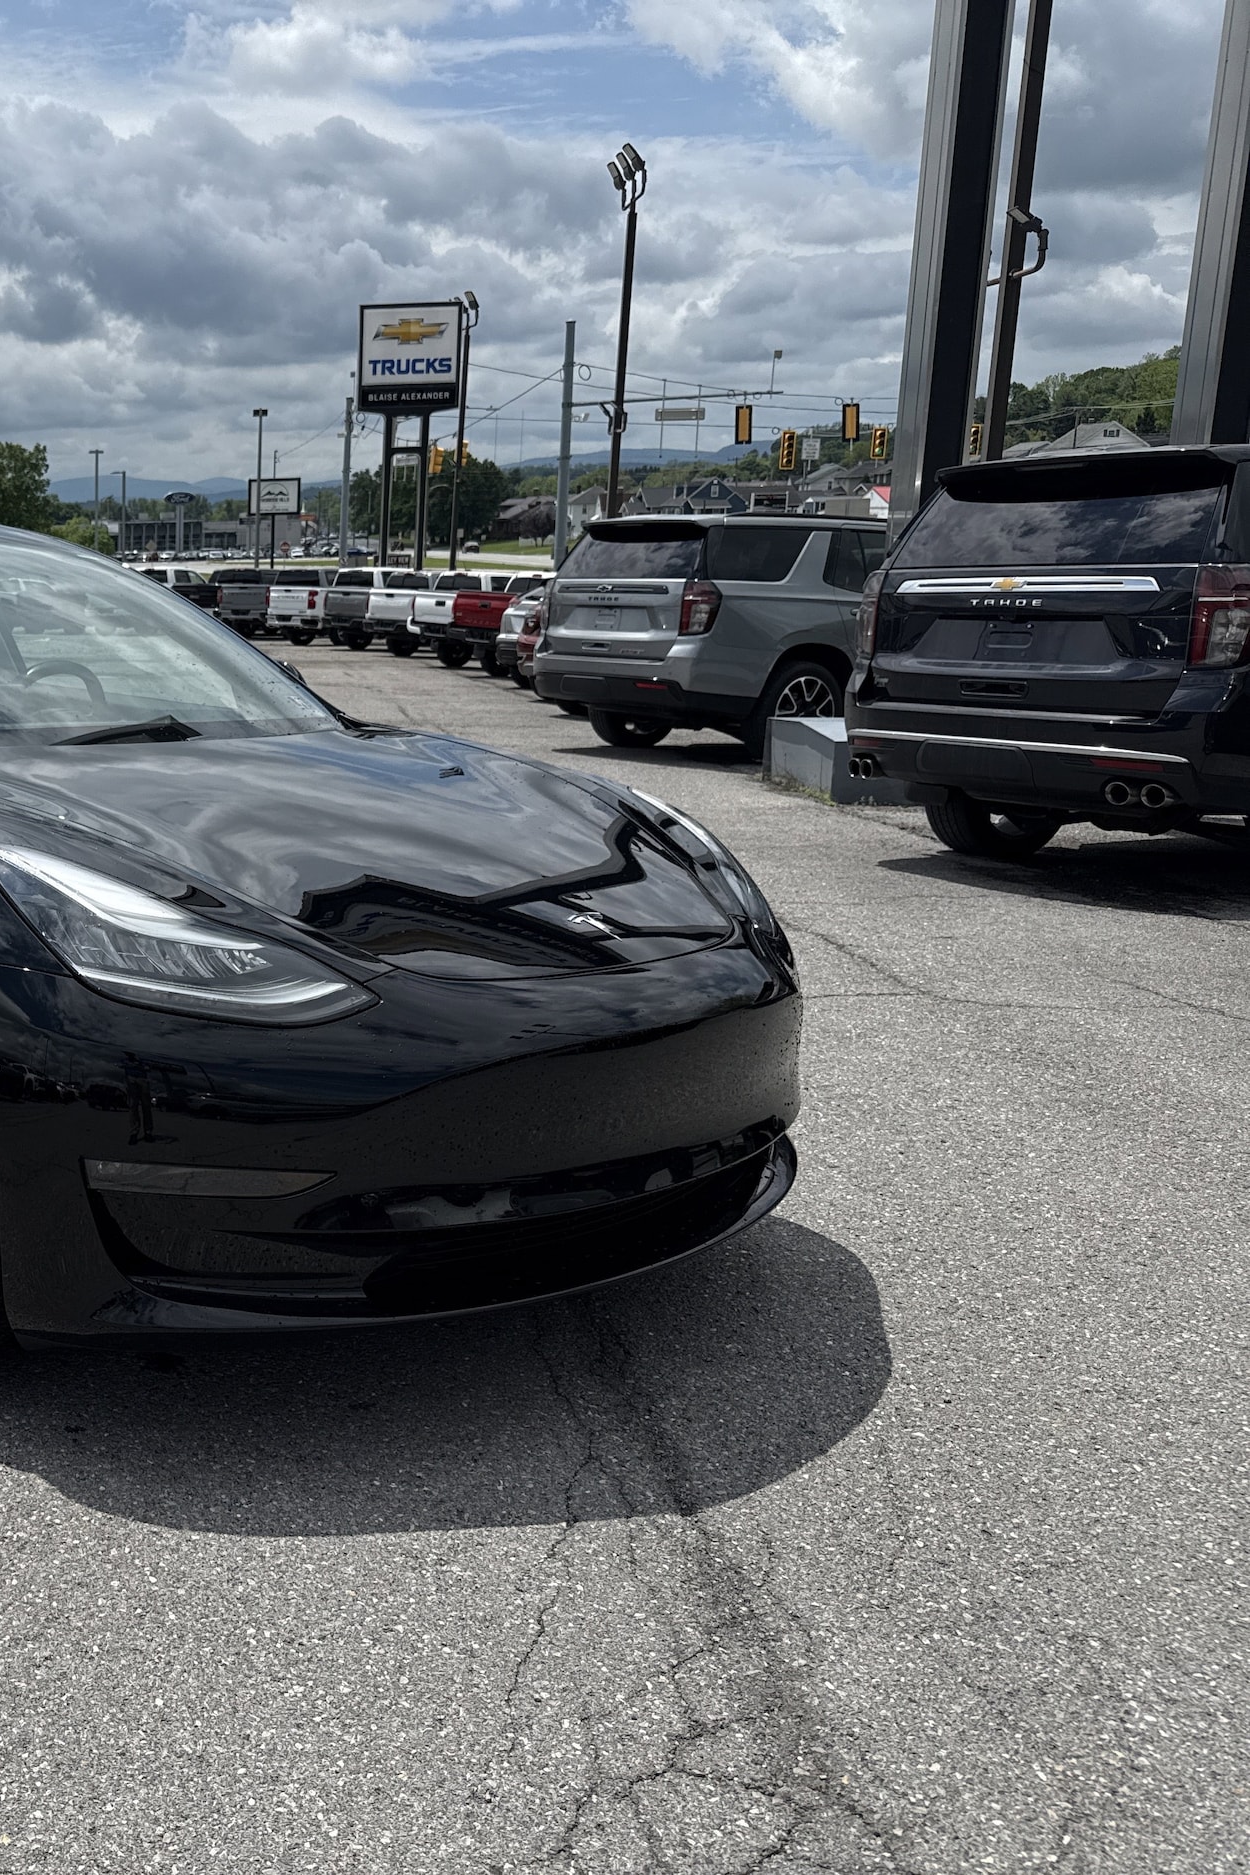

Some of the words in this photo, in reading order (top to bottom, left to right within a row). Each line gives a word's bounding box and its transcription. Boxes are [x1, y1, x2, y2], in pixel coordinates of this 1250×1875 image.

[368, 357, 452, 376] TRUCKS
[368, 393, 398, 402] BLAISE
[401, 391, 450, 401] ALEXANDER
[970, 598, 1043, 607] TAHOE
